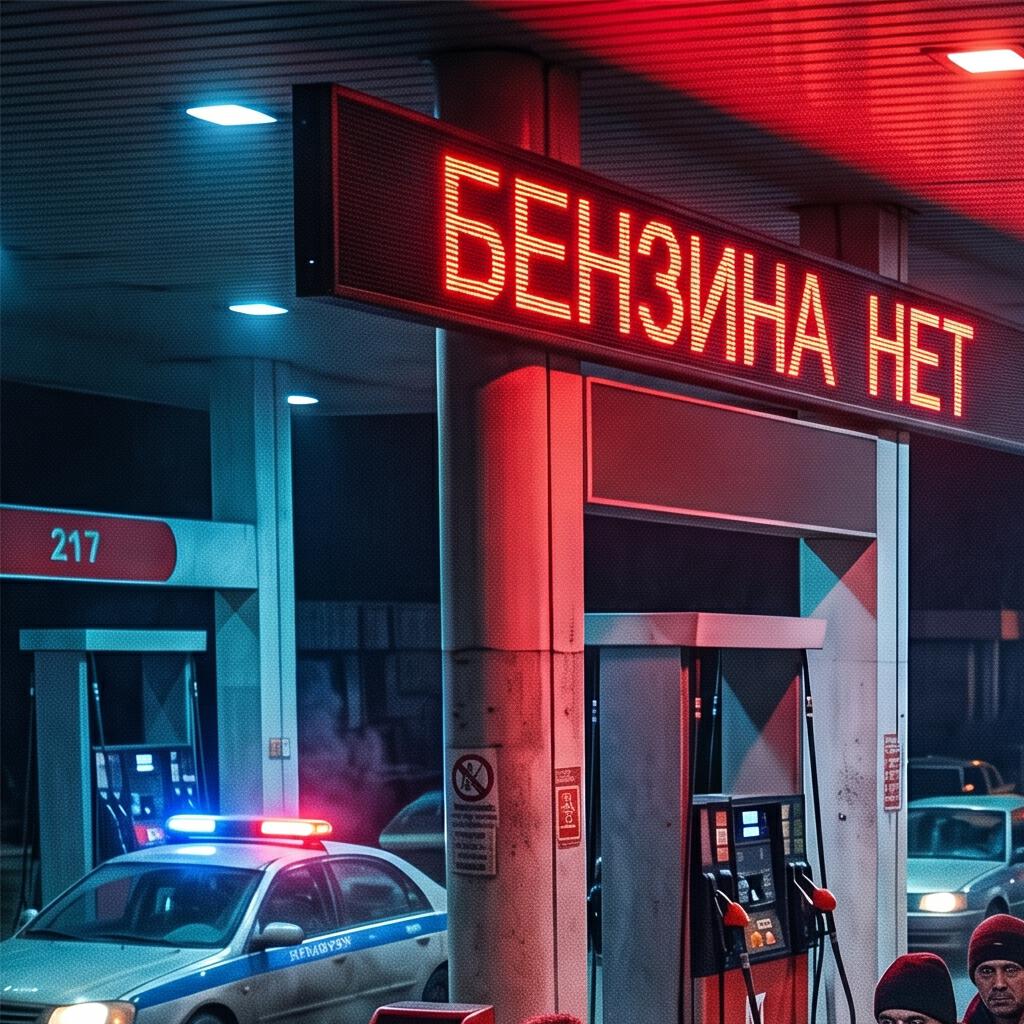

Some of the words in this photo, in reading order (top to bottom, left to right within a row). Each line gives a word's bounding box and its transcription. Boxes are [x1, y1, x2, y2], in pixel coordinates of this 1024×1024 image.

[443, 155, 836, 386] БЕНЗИНА
[868, 295, 975, 417] НЕТ
[50, 527, 100, 564] 217
